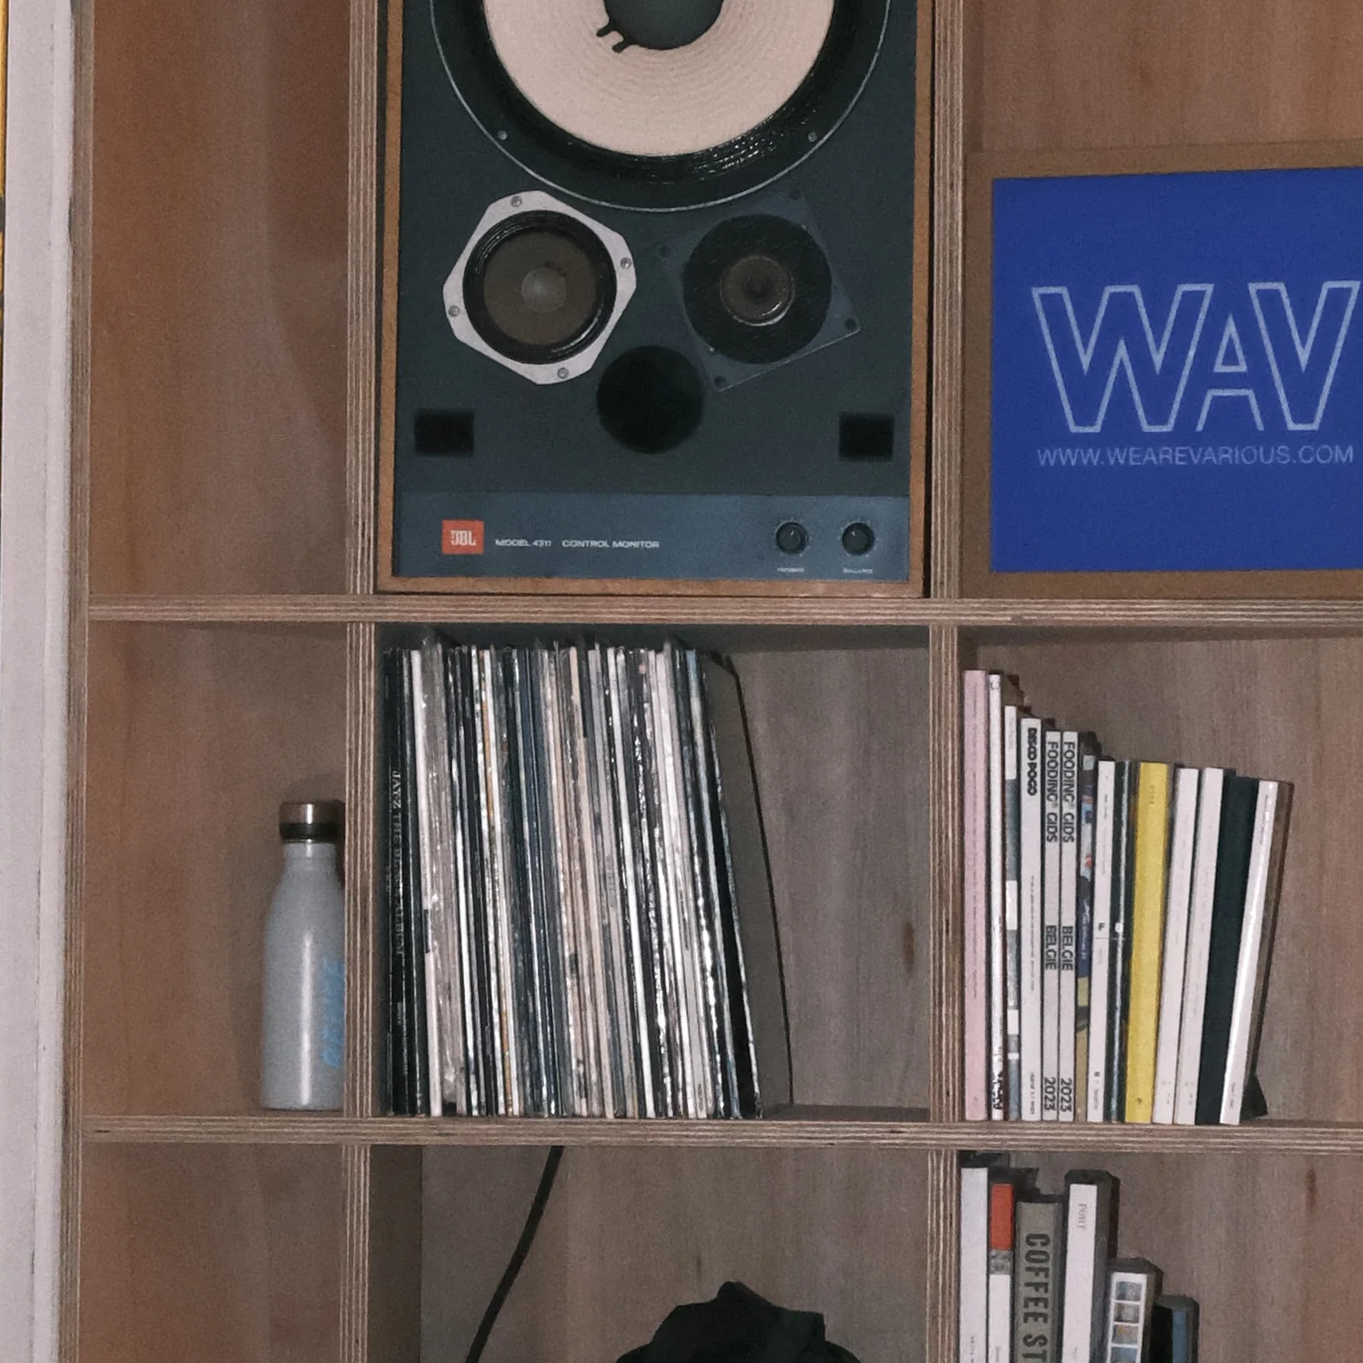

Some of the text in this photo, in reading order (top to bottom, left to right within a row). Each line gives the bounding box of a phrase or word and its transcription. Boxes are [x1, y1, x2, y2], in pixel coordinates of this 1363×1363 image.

[1031, 279, 1362, 434] WAV
[1036, 444, 1355, 467] WWW.WEAREVARIOUS.COM
[450, 529, 477, 547] JBL
[494, 538, 531, 547] MODEL
[561, 540, 610, 549] CONTROL
[612, 540, 659, 549] MONITOR
[1046, 811, 1058, 843] GIDS
[1062, 811, 1075, 843] GIDS
[1043, 1077, 1056, 1112] 2023
[1059, 1077, 1073, 1113] 2023
[1023, 1233, 1051, 1325] COFFEE
